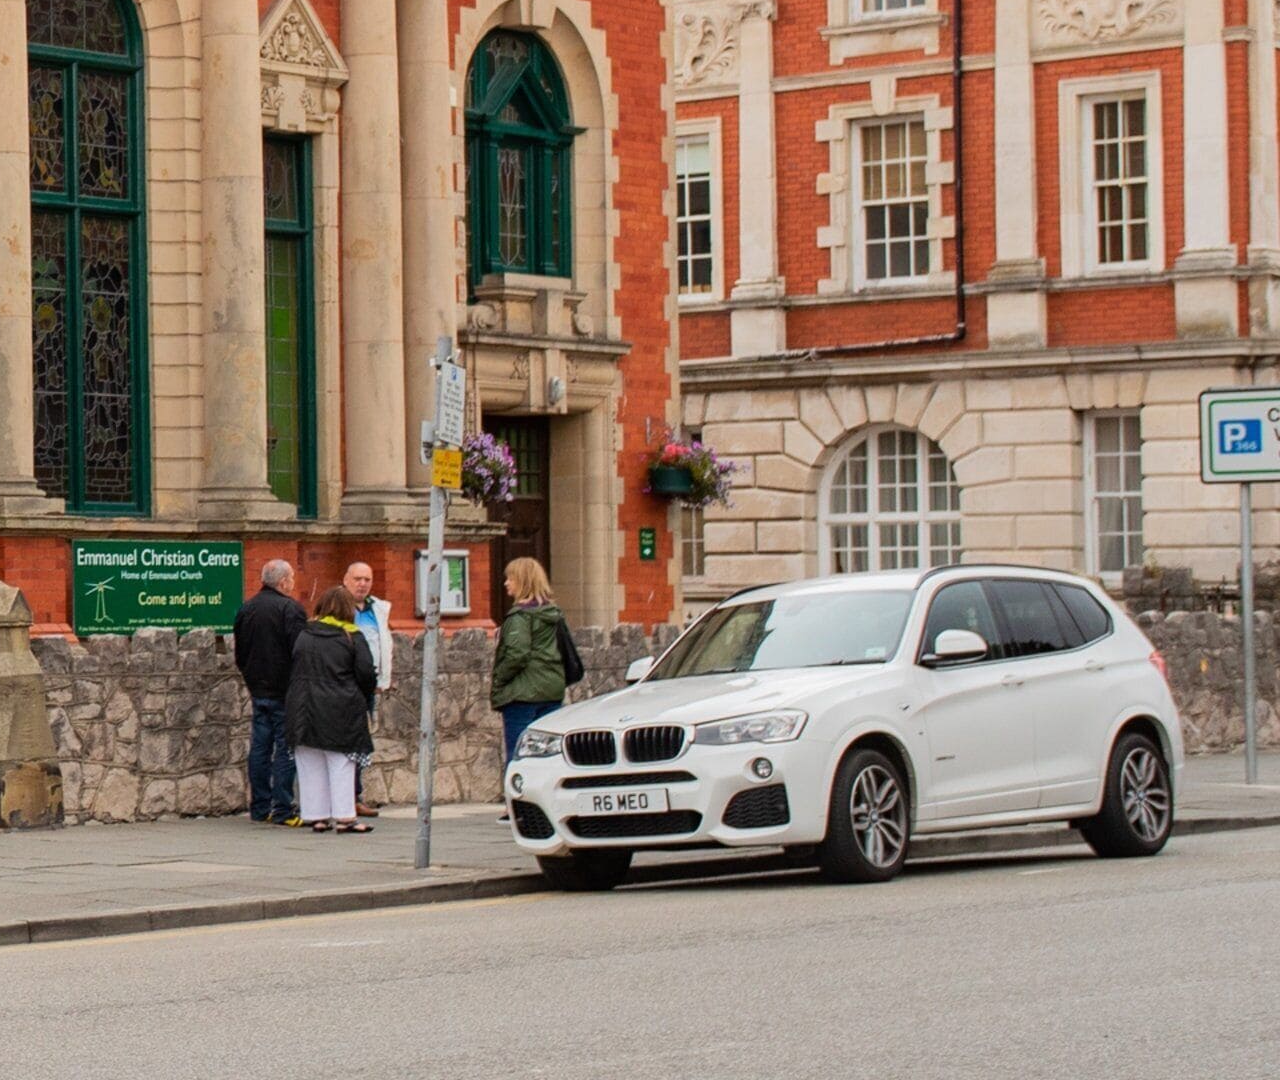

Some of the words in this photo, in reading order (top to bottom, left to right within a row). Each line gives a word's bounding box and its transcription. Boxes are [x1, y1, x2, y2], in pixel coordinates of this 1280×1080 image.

[1224, 423, 1246, 452] P
[77, 548, 137, 566] Emmanuel
[141, 548, 194, 566] Christian
[198, 549, 239, 566] Centre
[121, 571, 139, 579] Home
[141, 571, 148, 580] of
[149, 571, 179, 580] Emmanuel
[180, 571, 202, 580] Church
[138, 592, 166, 605] Come
[168, 592, 186, 605] and
[187, 592, 206, 608] join
[208, 592, 222, 605] us!
[593, 795, 613, 811] R6
[617, 793, 648, 810] MEO
